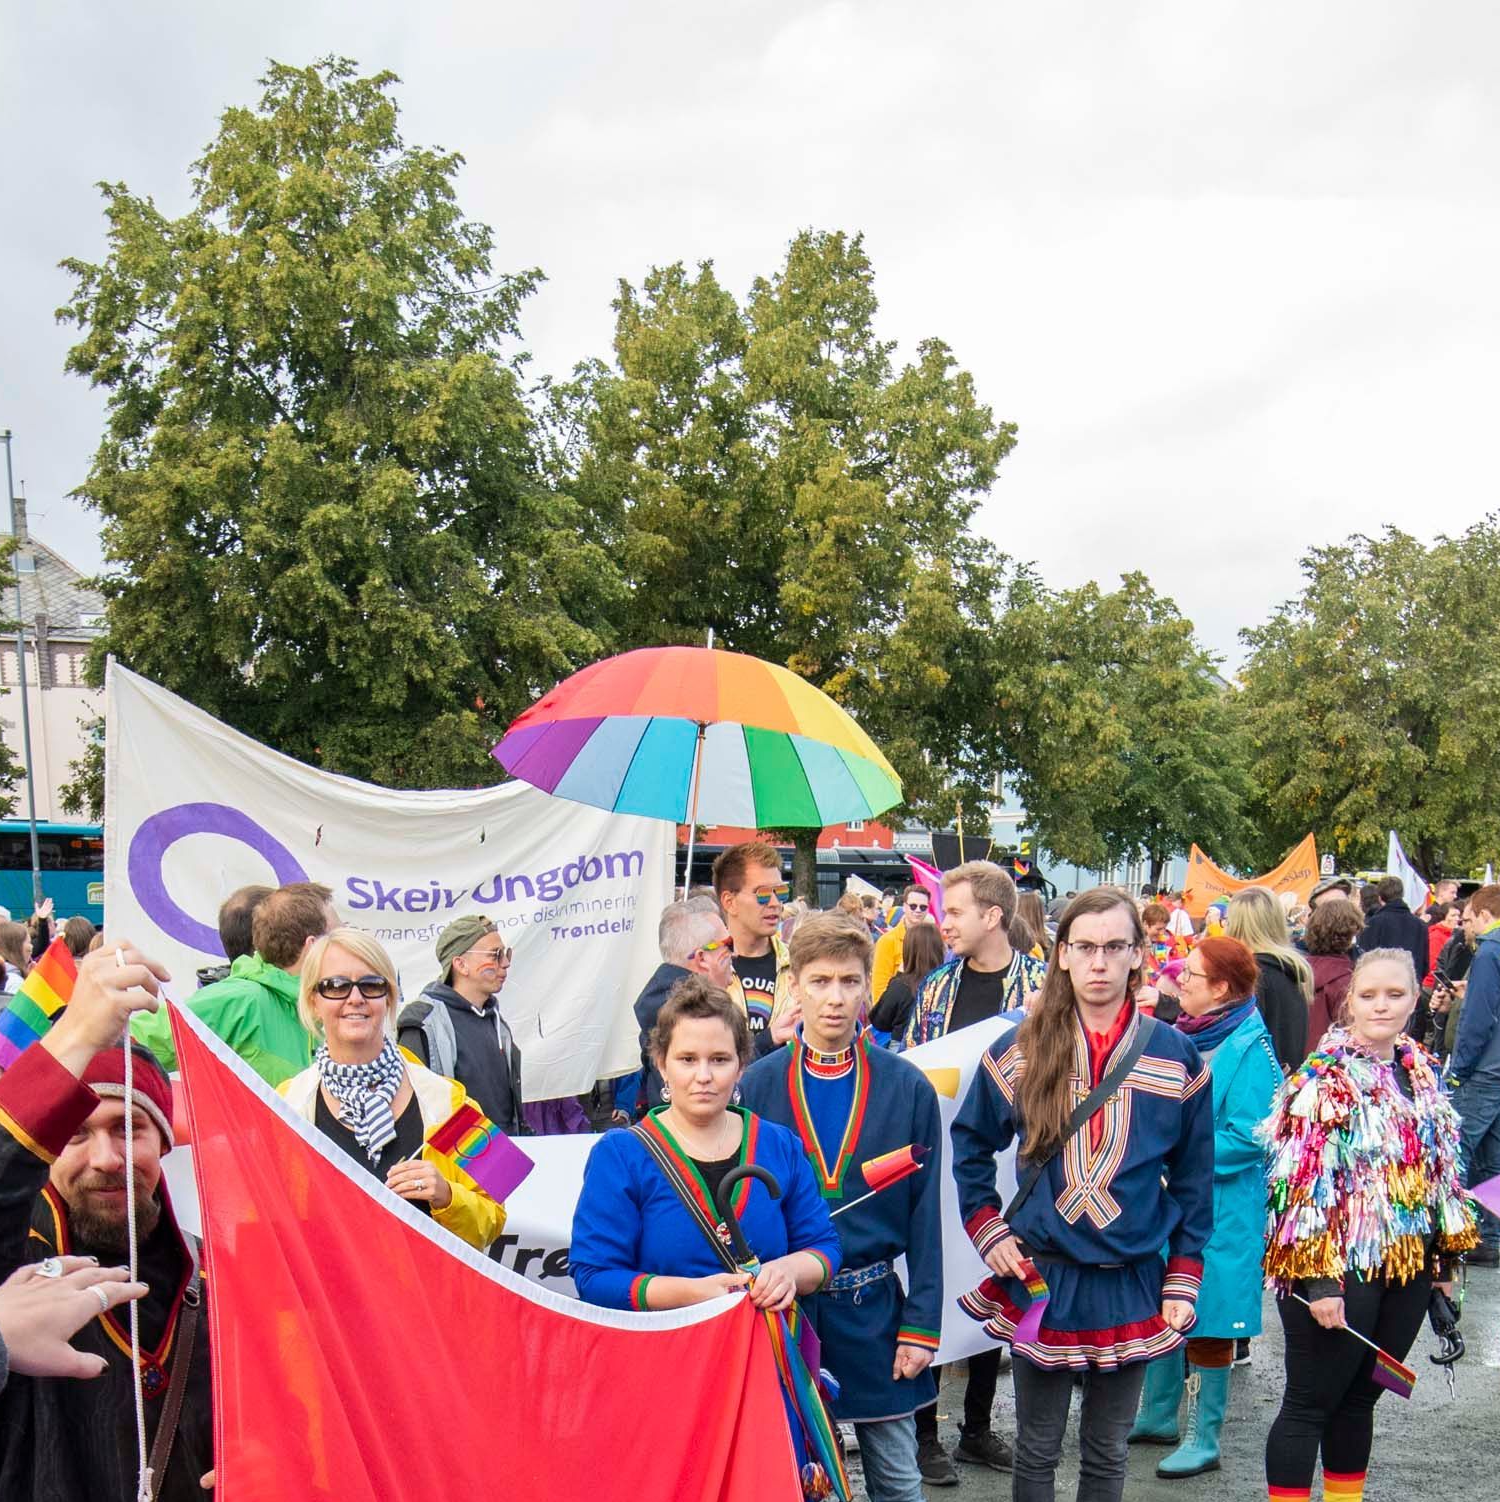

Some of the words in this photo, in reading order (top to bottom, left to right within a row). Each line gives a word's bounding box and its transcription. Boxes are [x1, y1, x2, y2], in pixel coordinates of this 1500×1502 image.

[346, 876, 467, 913] Skeiv
[471, 850, 644, 905] Ungdom
[533, 895, 637, 924] diskriminerin
[487, 1234, 571, 1280] Trø
